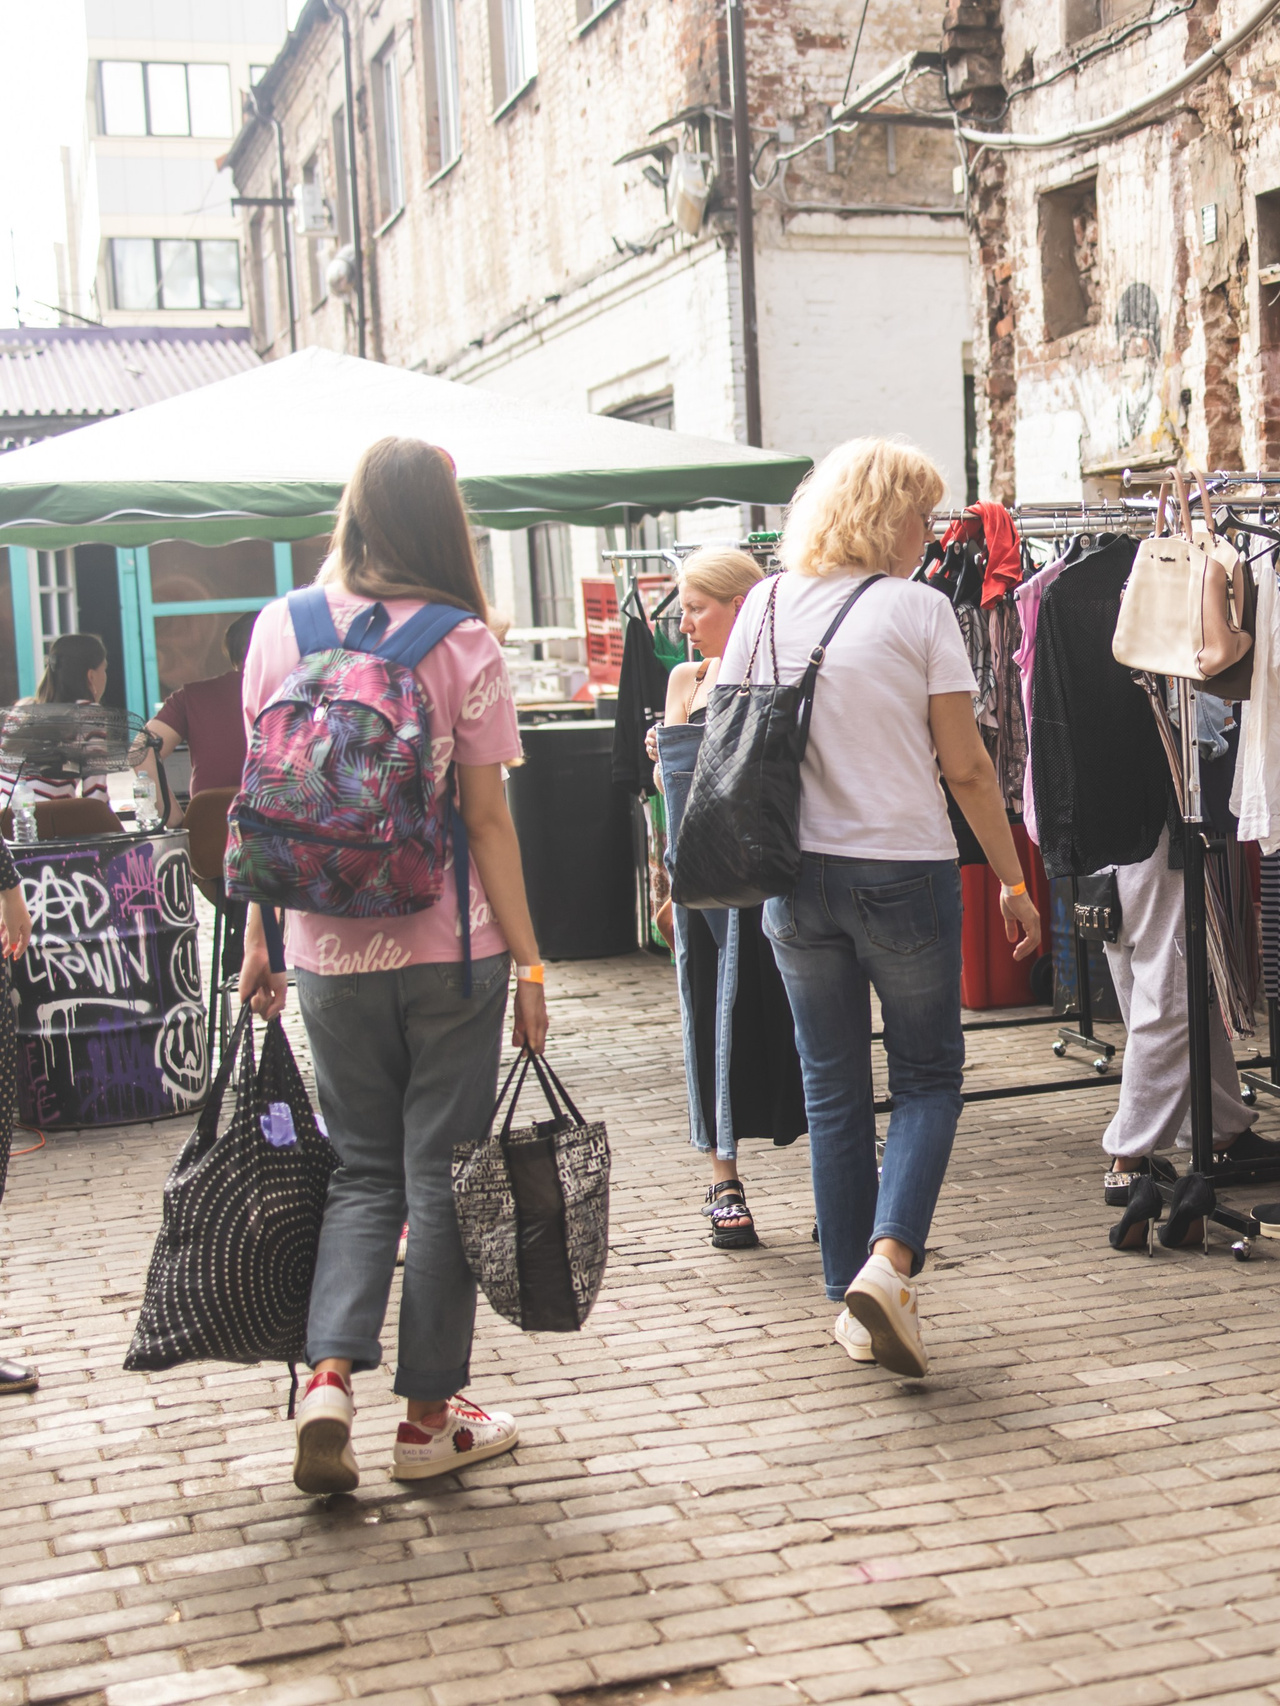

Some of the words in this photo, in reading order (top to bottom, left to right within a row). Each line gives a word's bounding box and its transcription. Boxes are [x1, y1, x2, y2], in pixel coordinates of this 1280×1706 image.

[21, 865, 109, 937] BAD
[24, 911, 149, 994] CROWN
[316, 931, 412, 976] Barbie
[589, 1136, 606, 1157] RT
[571, 1271, 590, 1291] AR
